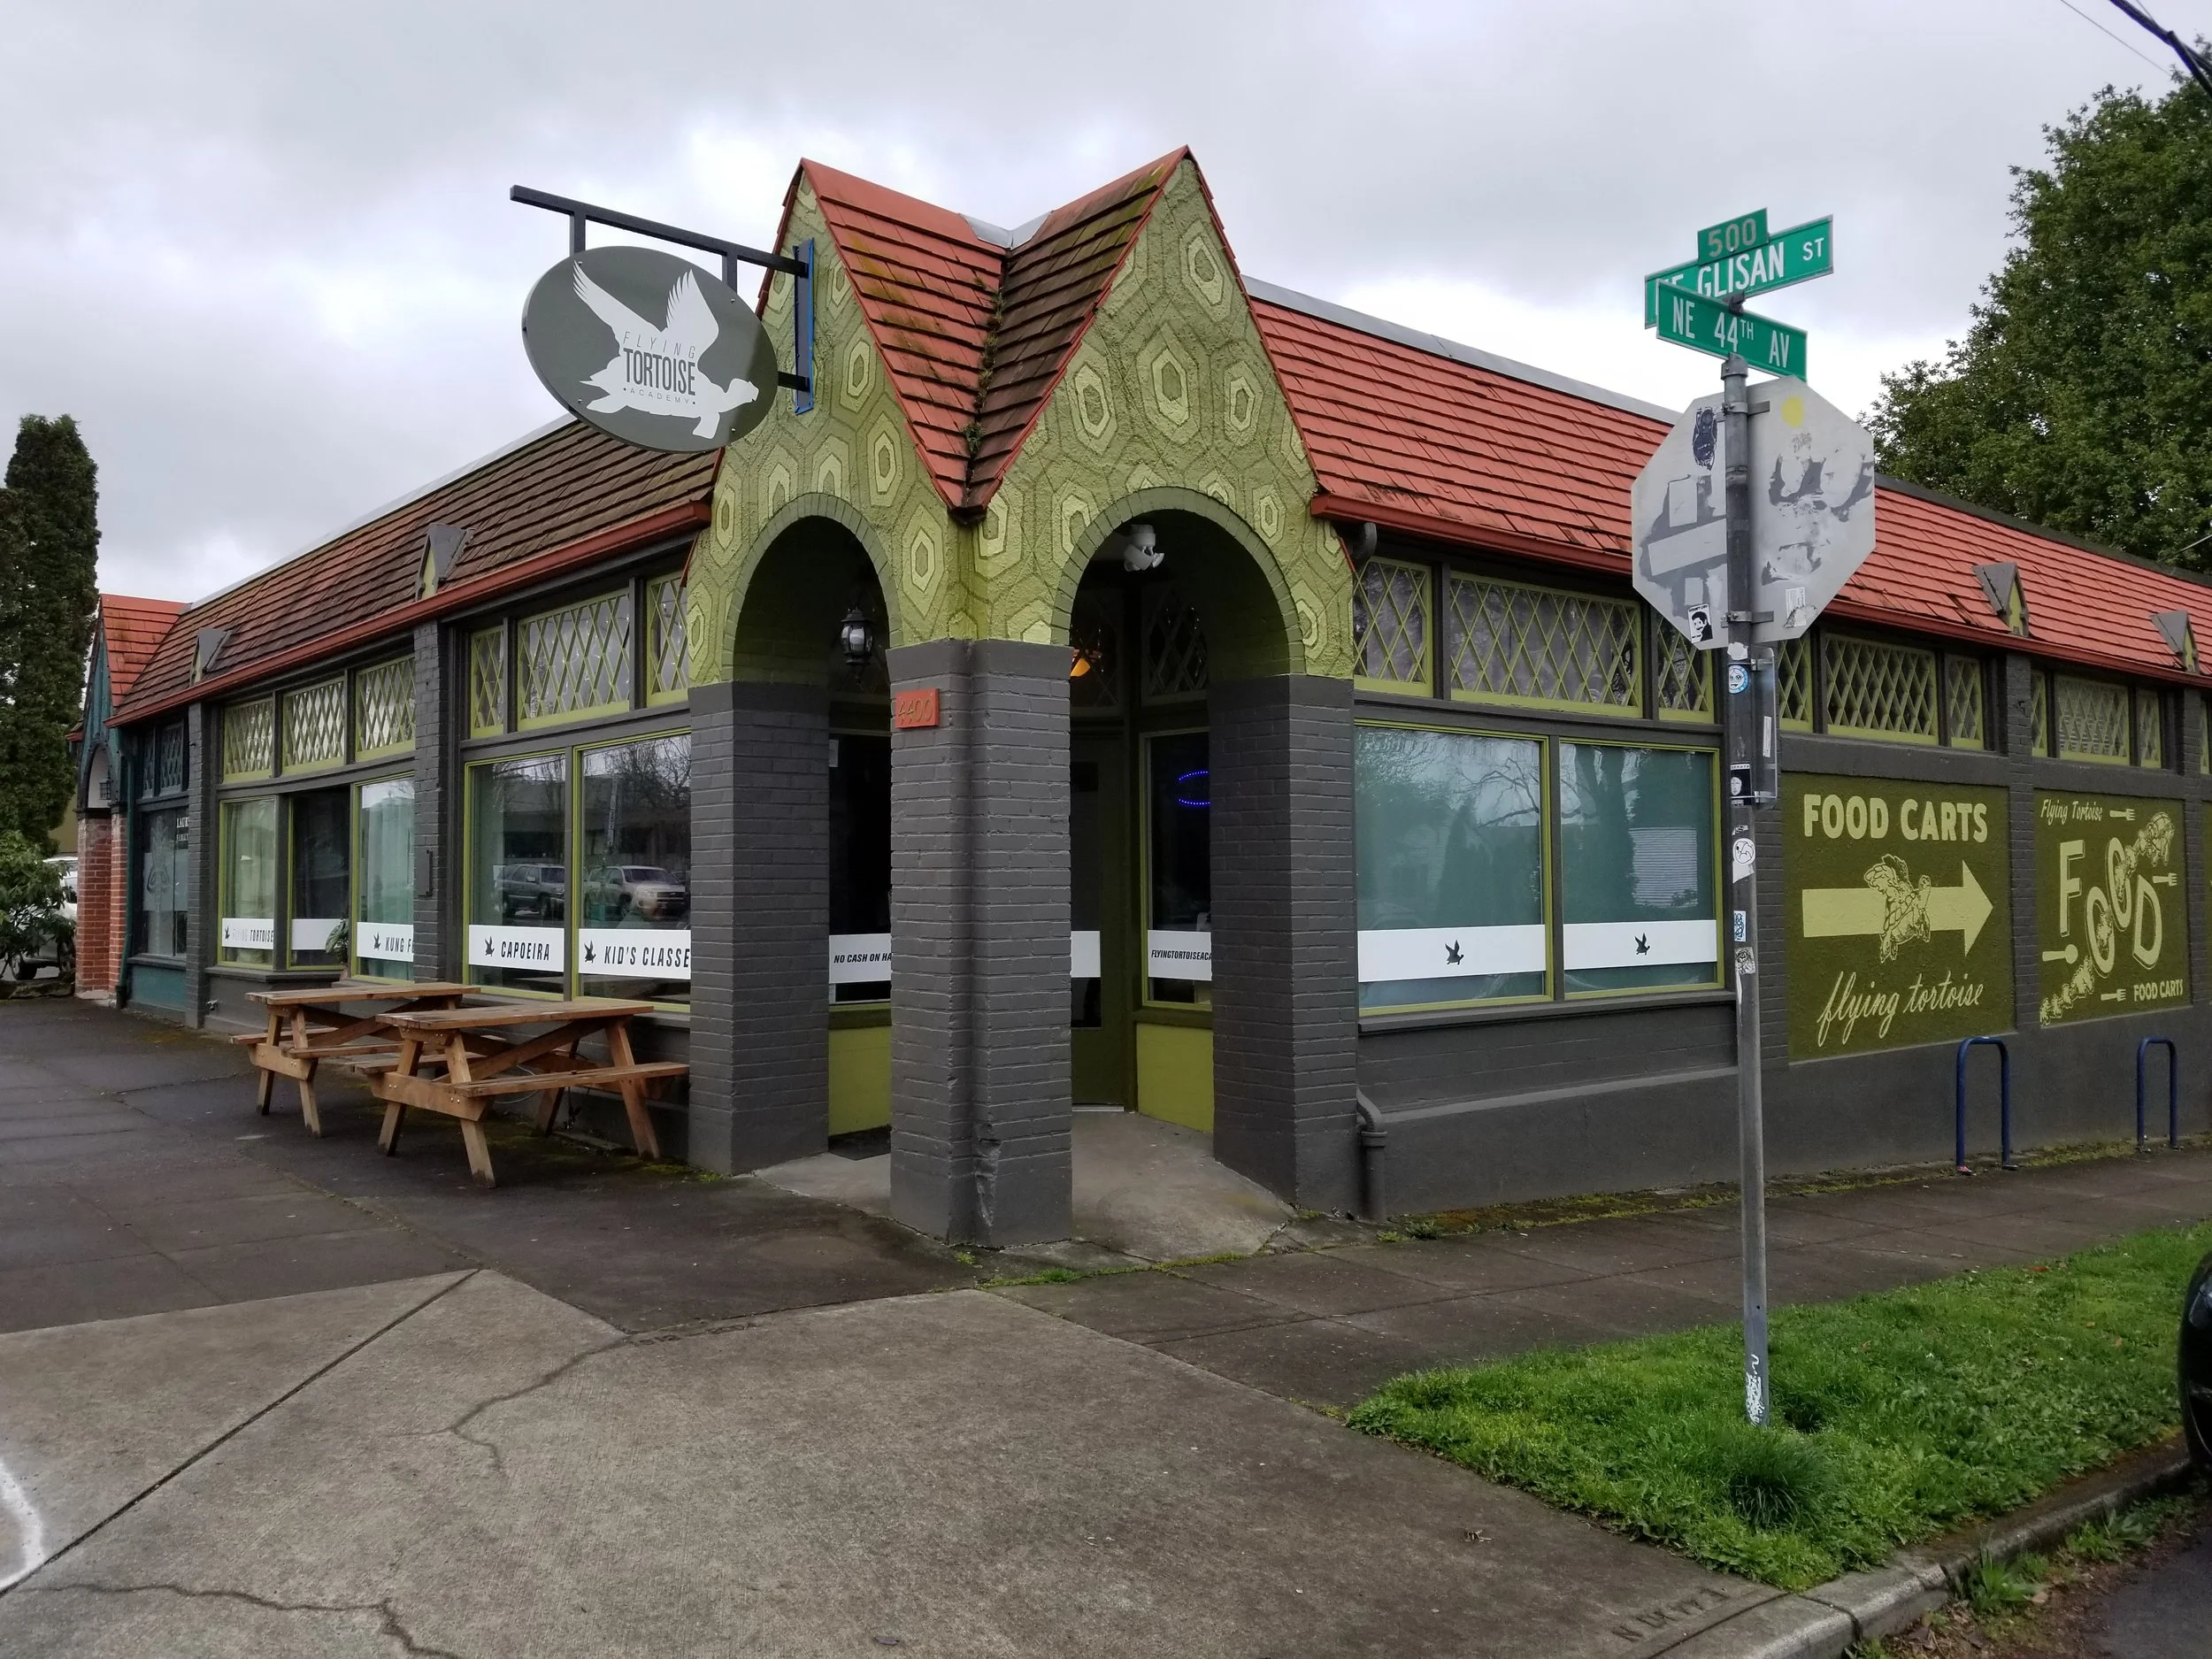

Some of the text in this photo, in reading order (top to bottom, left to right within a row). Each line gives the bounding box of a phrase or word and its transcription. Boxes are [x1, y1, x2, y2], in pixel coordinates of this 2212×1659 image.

[1708, 218, 1757, 257] 500
[1697, 242, 1785, 297] GLISAN
[1802, 237, 1824, 261] ST
[623, 331, 695, 359] FLYING
[1672, 296, 1790, 368] NE 44TH AV
[623, 347, 695, 396] TORTOISE
[630, 388, 689, 404] ACADEMY
[898, 698, 933, 725] 4400
[1803, 794, 1988, 843] FOOD CARTS
[2040, 798, 2103, 826] Flying Tortoise
[2060, 837, 2162, 979] FOOD
[250, 929, 274, 943] TORTOISE
[385, 936, 414, 954] KUNG F
[501, 941, 550, 961] CAPOEIRA
[604, 945, 690, 968] KID'S CLASSE
[833, 955, 845, 964] NO
[847, 954, 868, 963] CASH
[869, 953, 880, 962] ON
[2133, 979, 2184, 1002] FOOD CARTS
[1817, 971, 1984, 1048] flying tortoise
